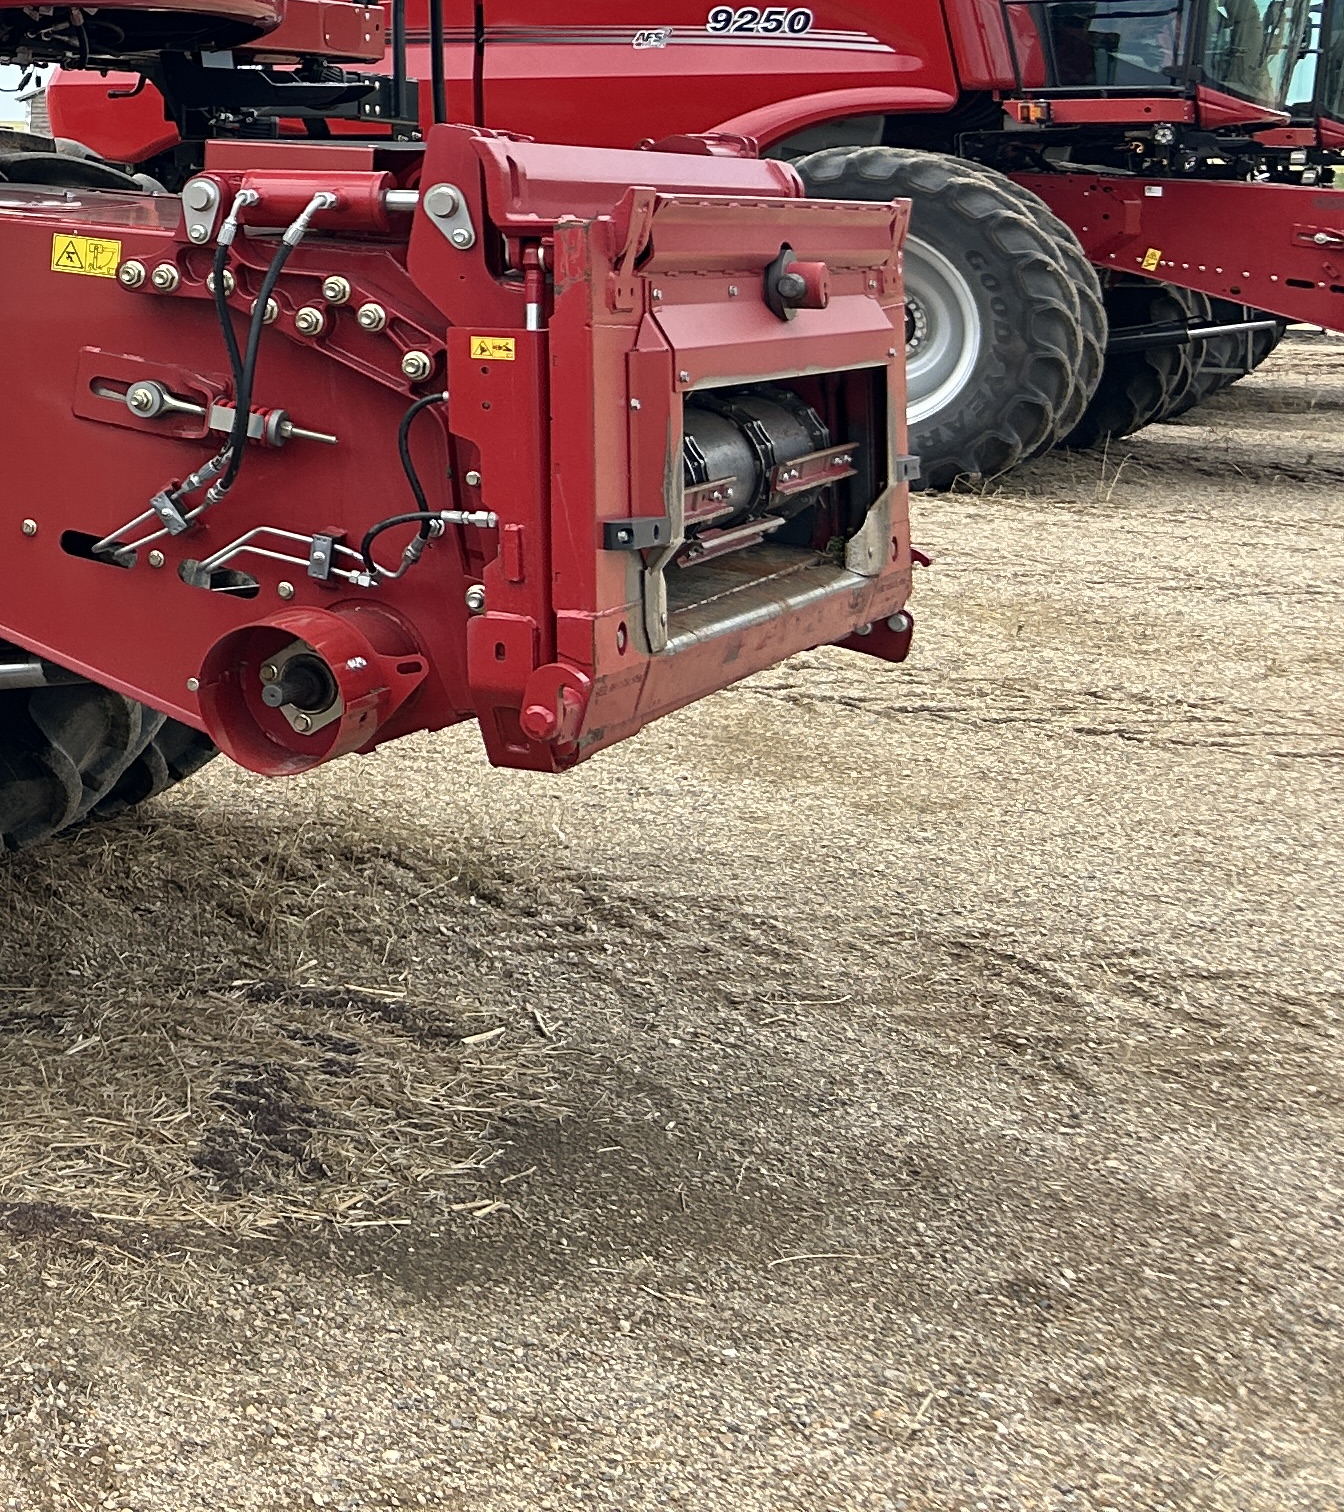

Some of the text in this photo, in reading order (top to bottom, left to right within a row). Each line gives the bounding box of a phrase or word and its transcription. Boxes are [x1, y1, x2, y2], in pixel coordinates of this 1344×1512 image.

[706, 5, 813, 34] 9250
[632, 30, 666, 44] AFS
[915, 249, 1012, 449] GOODYEAR
